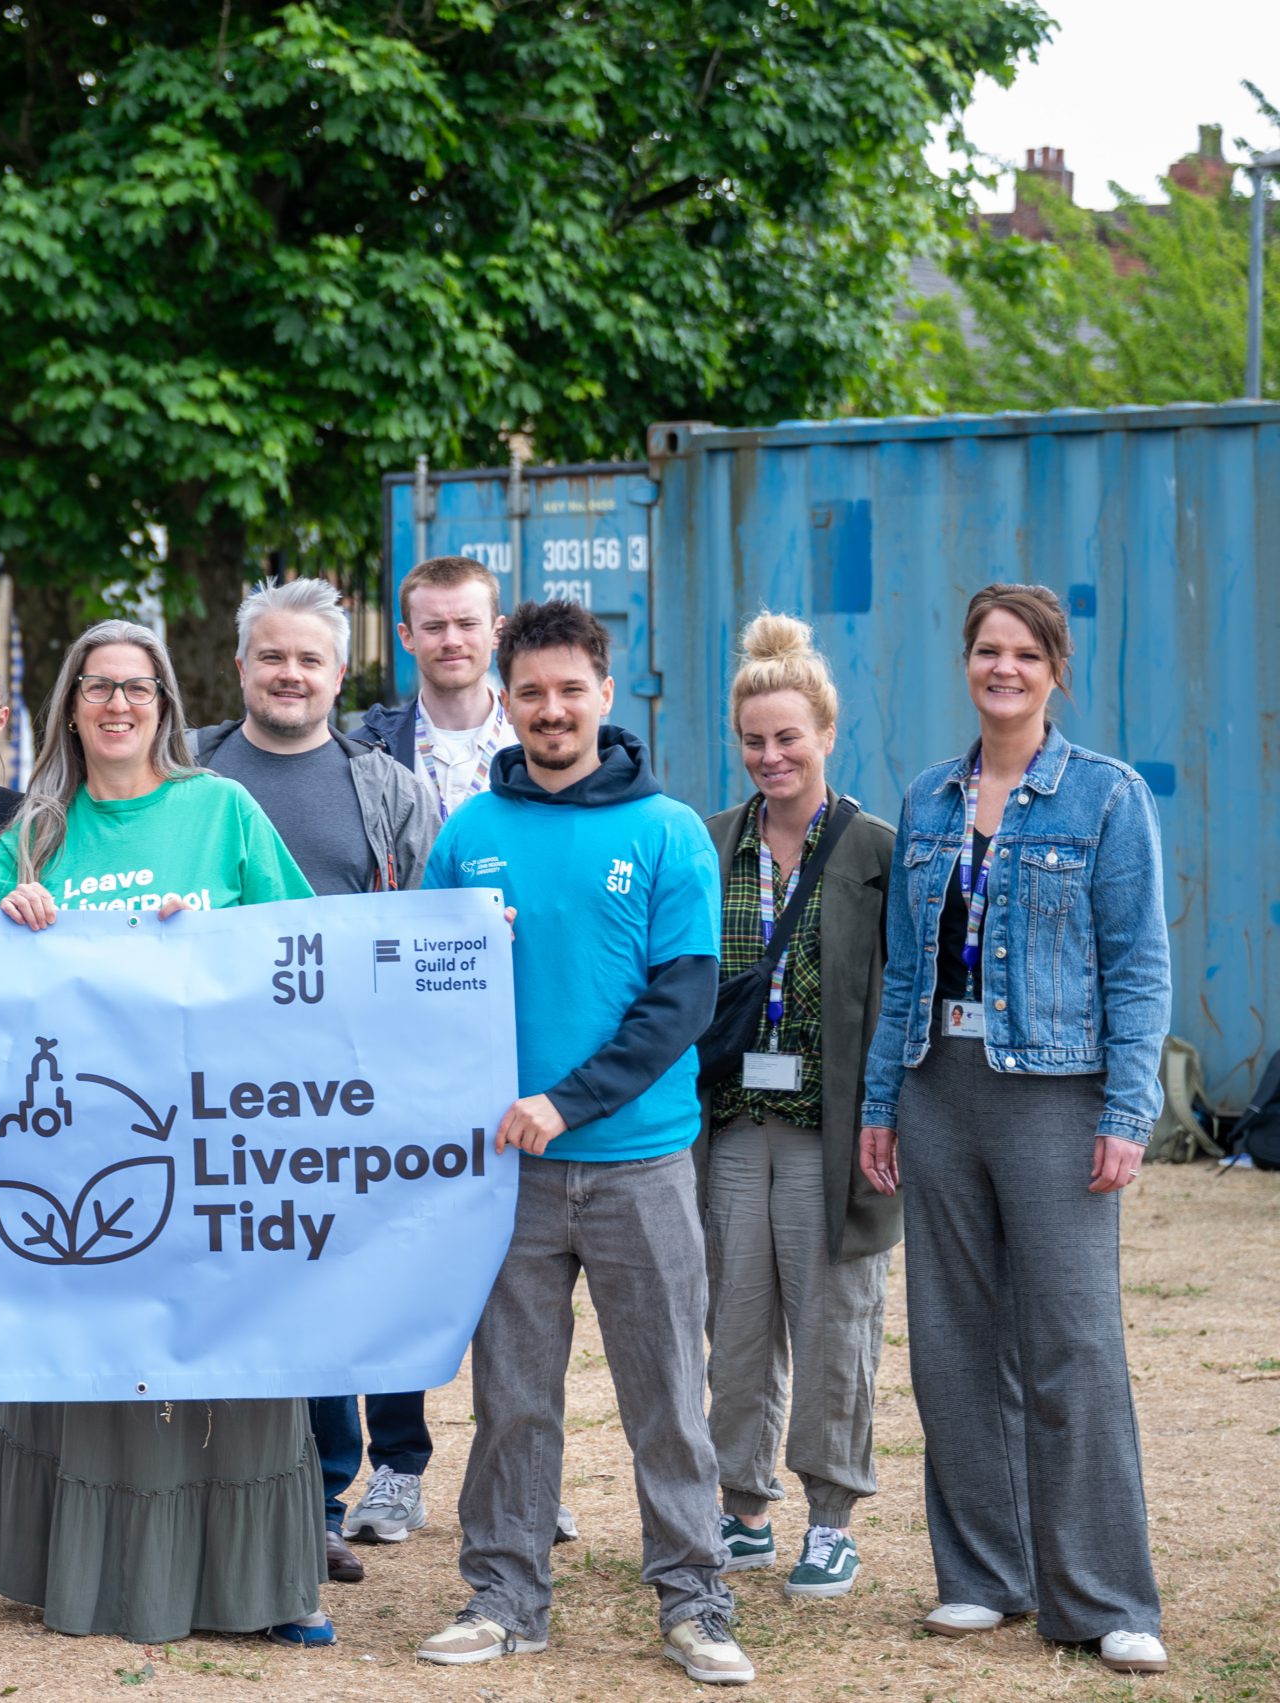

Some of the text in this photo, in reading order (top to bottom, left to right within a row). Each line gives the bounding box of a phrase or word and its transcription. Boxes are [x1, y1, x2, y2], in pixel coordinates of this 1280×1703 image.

[543, 538, 622, 573] 303156
[629, 536, 646, 571] 3
[64, 868, 154, 899] Leave
[607, 875, 631, 894] SU
[609, 859, 633, 878] JM
[274, 932, 324, 967] JM
[414, 935, 487, 954] Liverpool
[415, 956, 476, 974] Guild of
[272, 970, 324, 1005] SU
[415, 976, 487, 992] Students
[190, 1071, 375, 1120] Leave
[192, 1127, 486, 1195] Liverpool
[192, 1199, 336, 1261] Tidy
